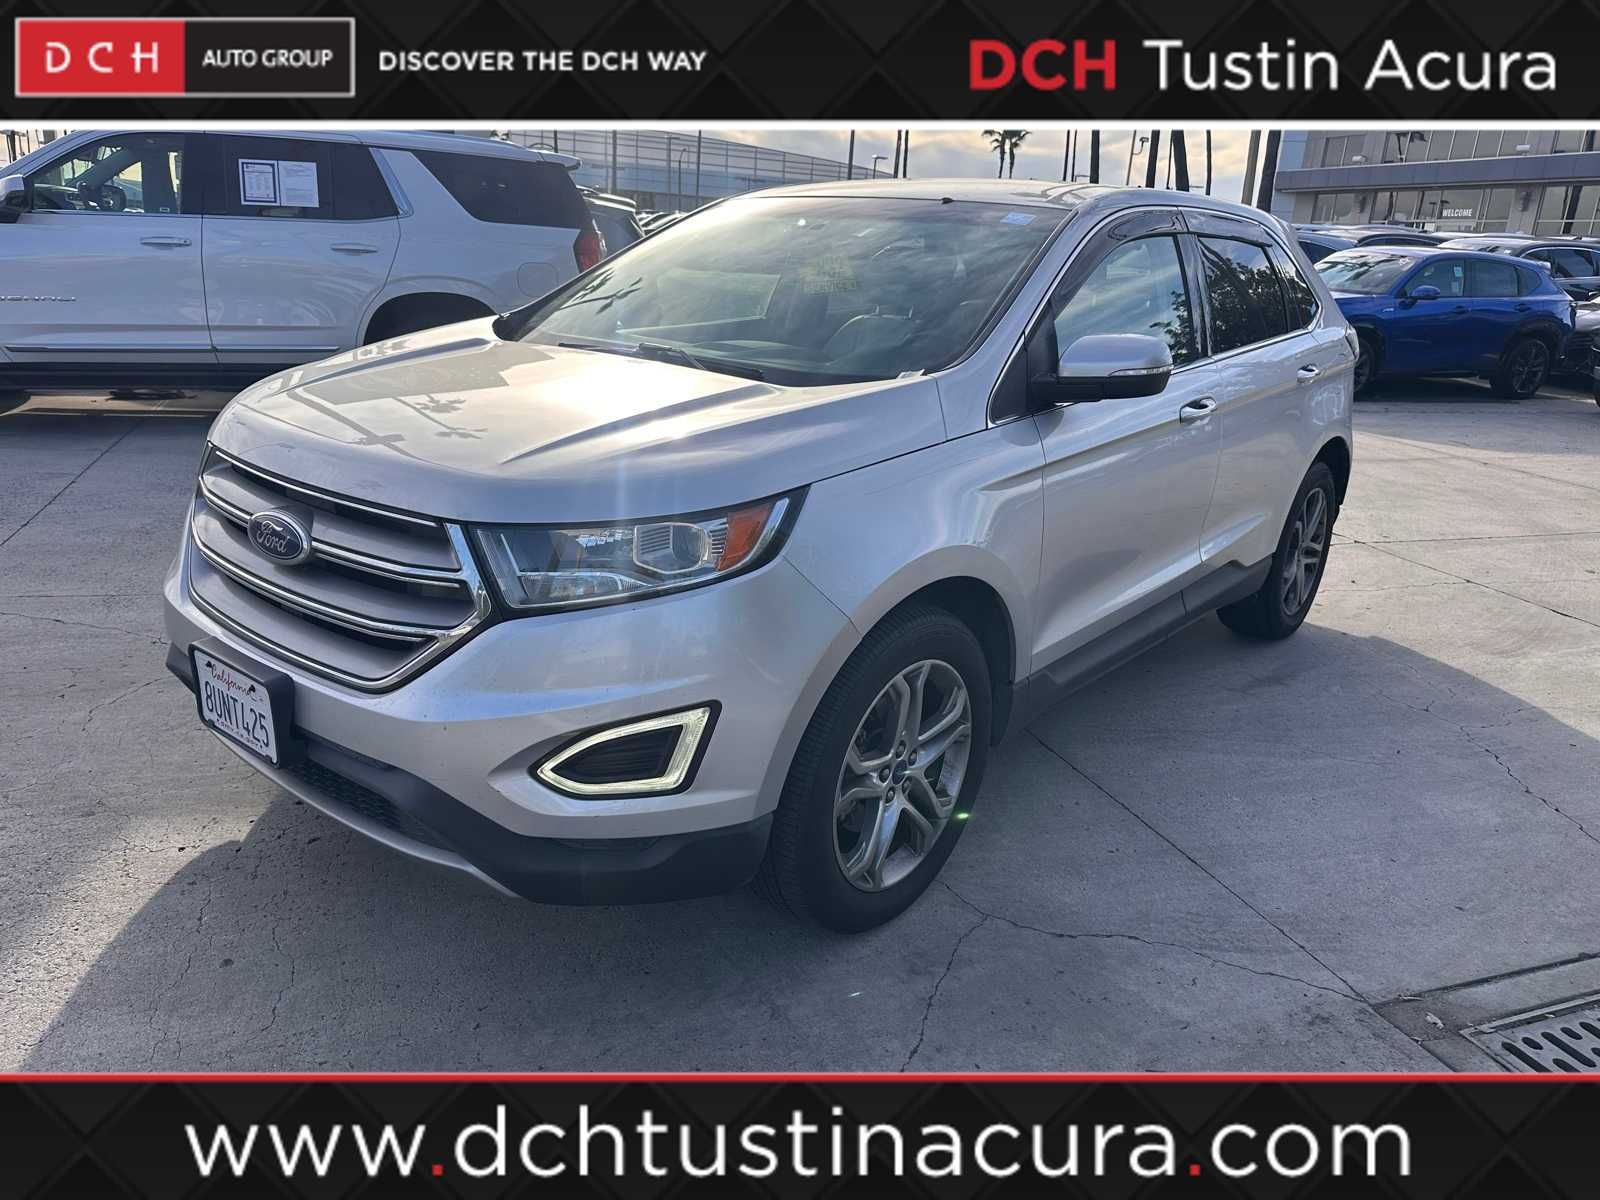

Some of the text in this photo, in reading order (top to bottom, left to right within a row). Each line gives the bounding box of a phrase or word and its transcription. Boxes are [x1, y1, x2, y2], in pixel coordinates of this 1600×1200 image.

[1442, 208, 1473, 217] WELCOME
[256, 520, 290, 553] Ford
[204, 680, 270, 748] 8UNT425
